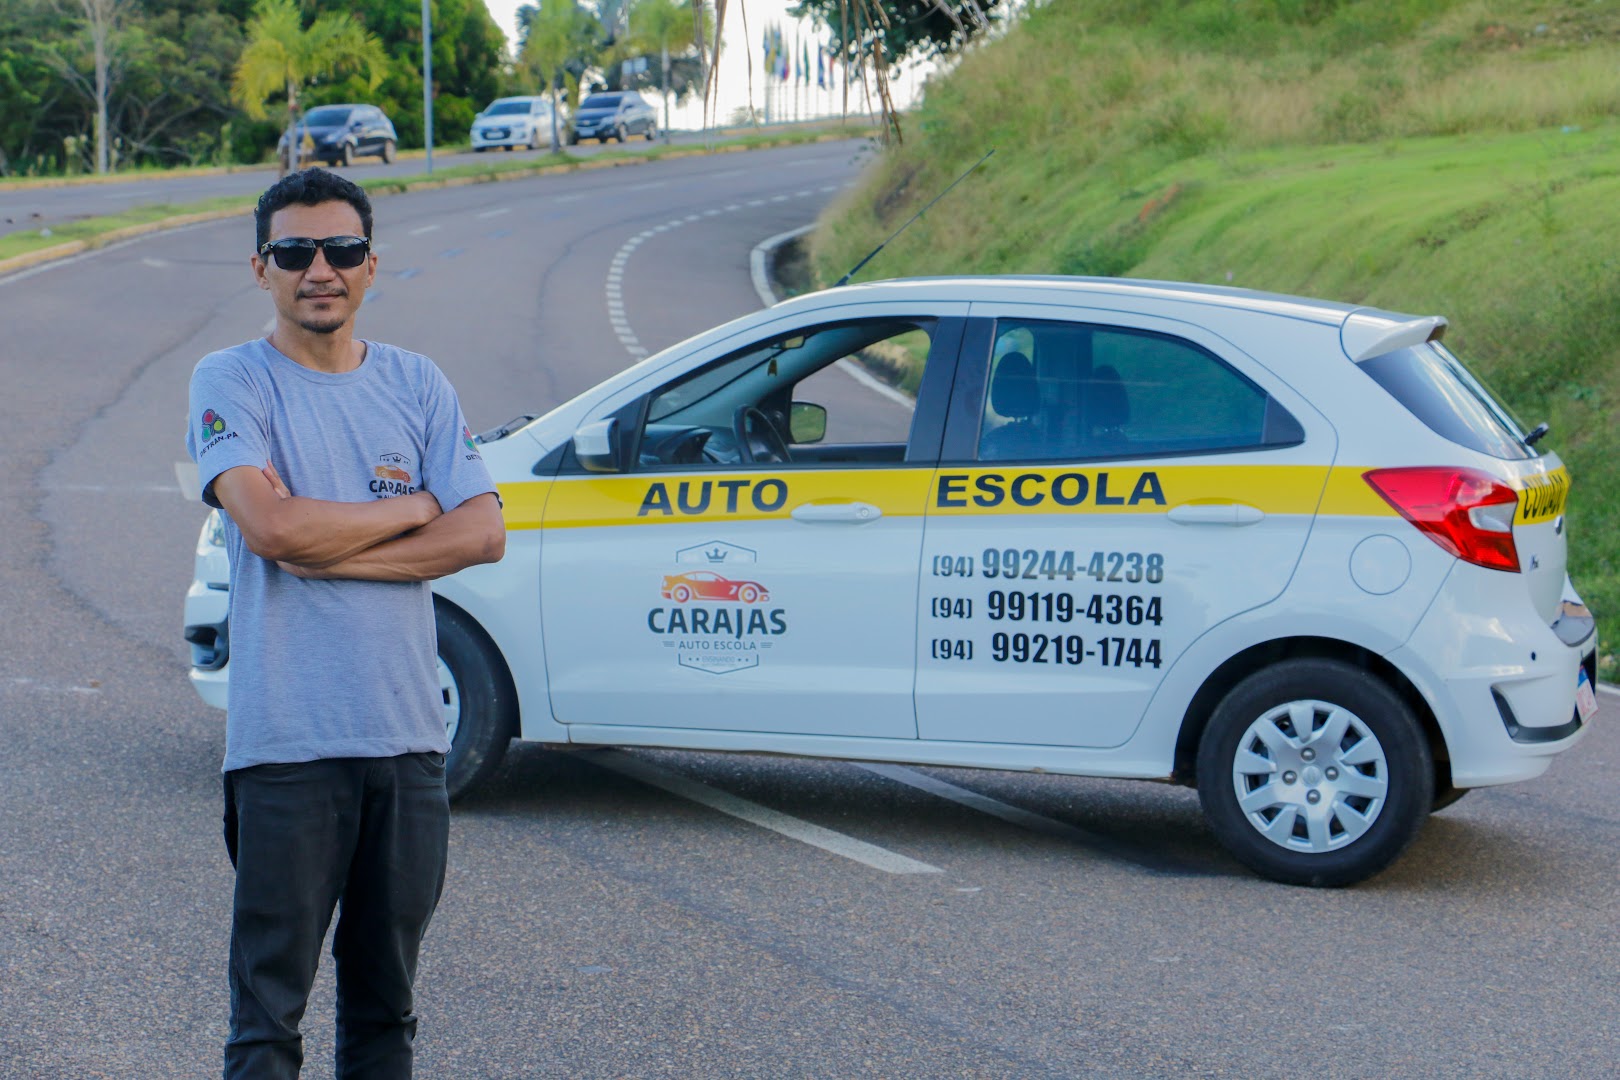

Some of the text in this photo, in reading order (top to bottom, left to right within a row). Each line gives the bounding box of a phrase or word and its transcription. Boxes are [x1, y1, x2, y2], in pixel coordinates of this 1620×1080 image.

[637, 472, 1167, 516] AUTO ESCOLA
[933, 548, 1164, 584] (94) 99244-4238
[647, 607, 787, 640] CARAJAS
[932, 590, 1163, 626] (94) 99119-4364
[678, 641, 757, 650] AUTO ESCOLA
[932, 632, 1163, 669] (94) 99219-1744
